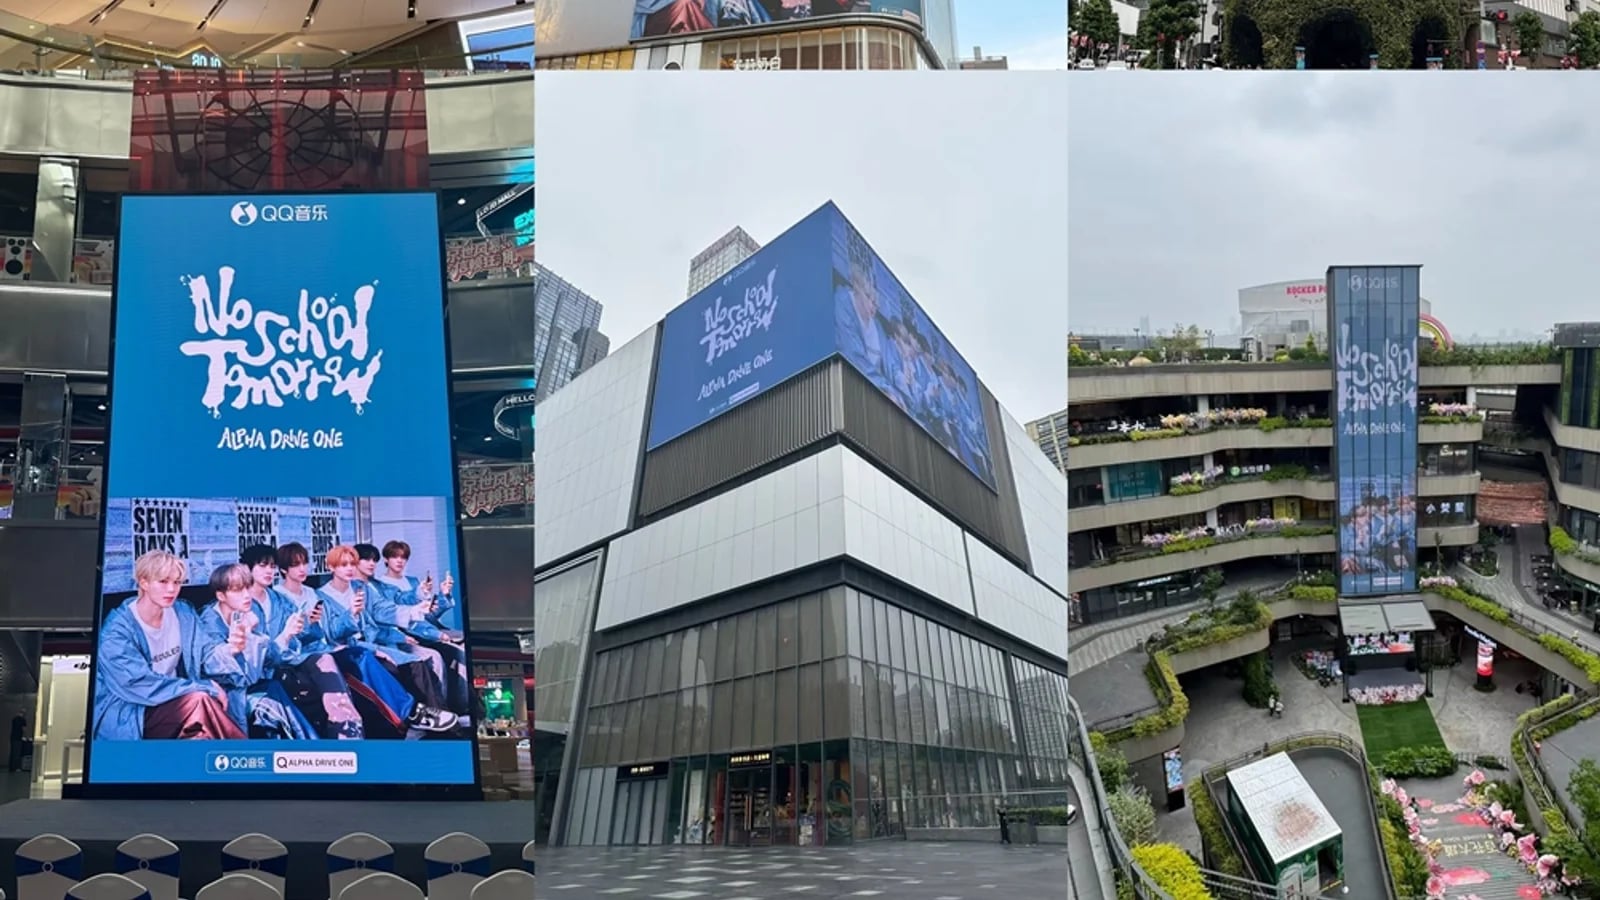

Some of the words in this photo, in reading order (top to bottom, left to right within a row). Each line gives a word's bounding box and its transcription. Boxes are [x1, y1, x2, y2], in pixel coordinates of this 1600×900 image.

[261, 204, 328, 222] QQ音乐
[705, 296, 728, 333] No
[727, 268, 777, 335] School
[188, 266, 253, 336] No
[237, 284, 375, 366] School
[700, 296, 779, 365] Tomorrow
[180, 339, 383, 411] Tomorrow
[697, 376, 726, 401] ALPHA
[728, 361, 752, 385] DRIVE
[754, 349, 773, 369] ONE
[217, 427, 267, 450] ALPHA
[270, 428, 309, 449] DRIVE
[313, 428, 343, 448] ONE
[134, 506, 183, 534] SEVEN
[238, 512, 272, 535] SEVEN
[311, 516, 337, 535] SEVEN
[134, 534, 176, 561] DAYS
[179, 534, 188, 559] A
[289, 758, 313, 768] ALPHA
[315, 758, 337, 768] DRIVE
[338, 758, 354, 768] ONE
